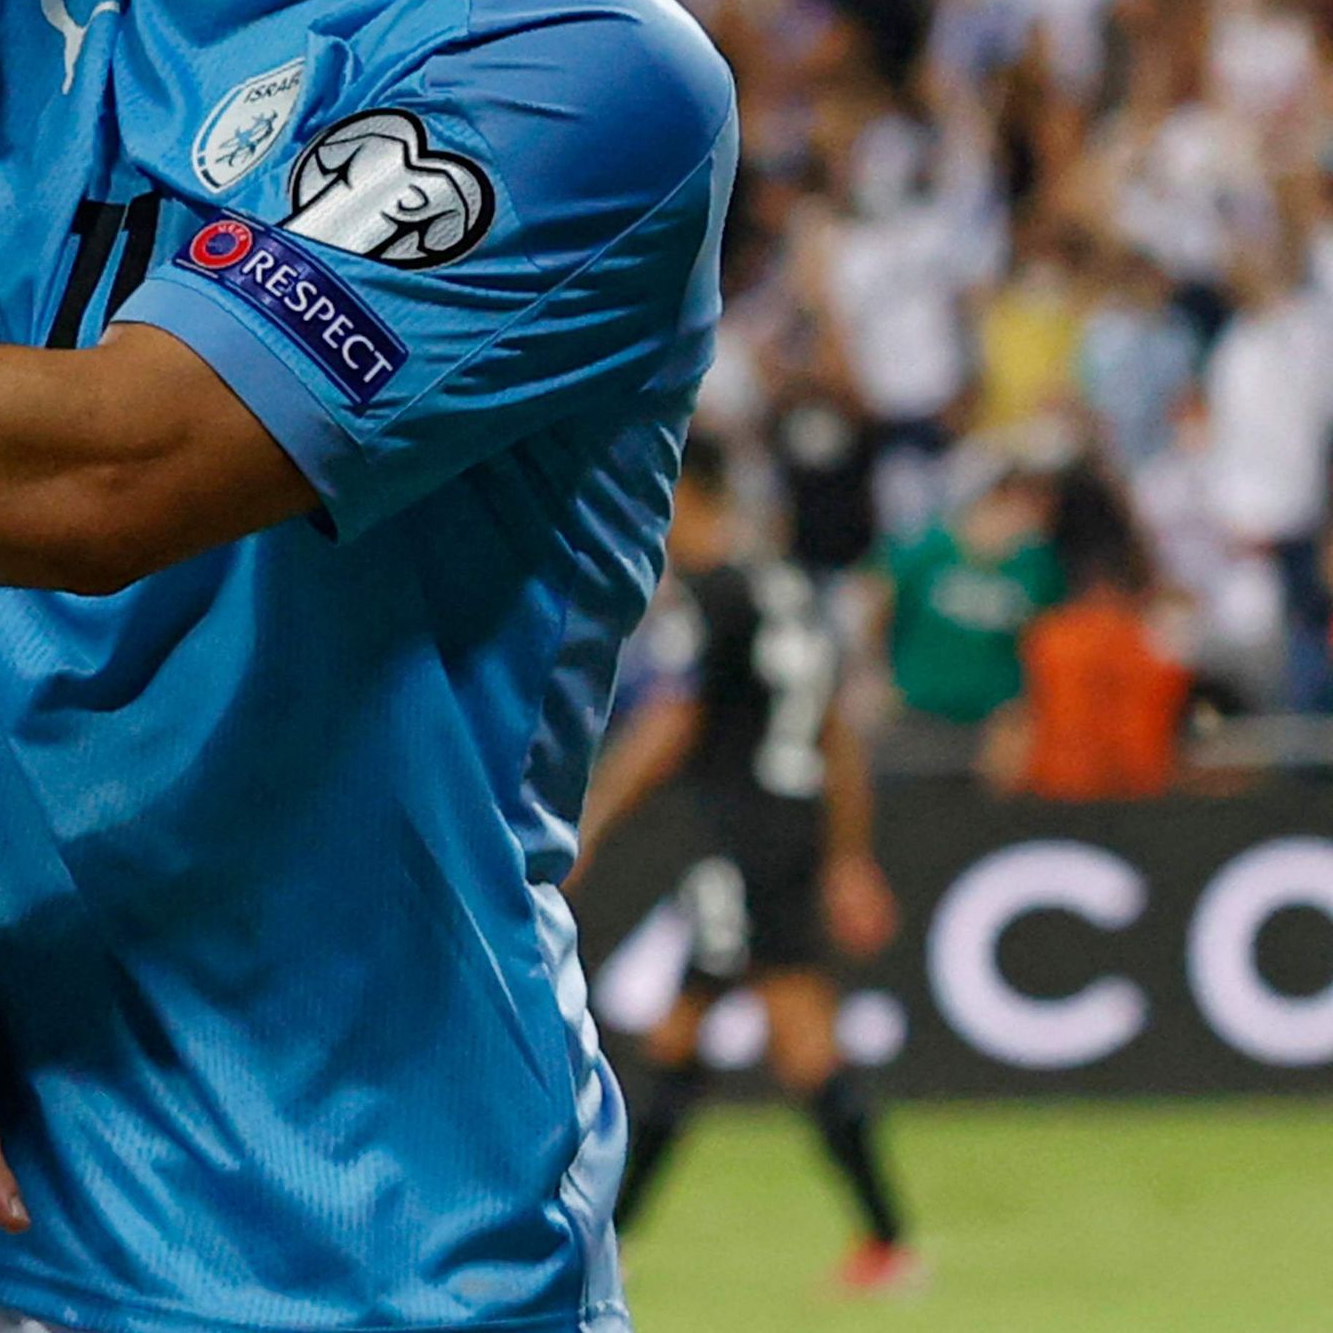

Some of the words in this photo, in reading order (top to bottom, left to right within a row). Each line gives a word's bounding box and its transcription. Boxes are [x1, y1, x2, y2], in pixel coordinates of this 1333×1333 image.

[242, 69, 302, 103] ISRAE
[45, 190, 161, 349] 11
[242, 250, 393, 383] RESPECT
